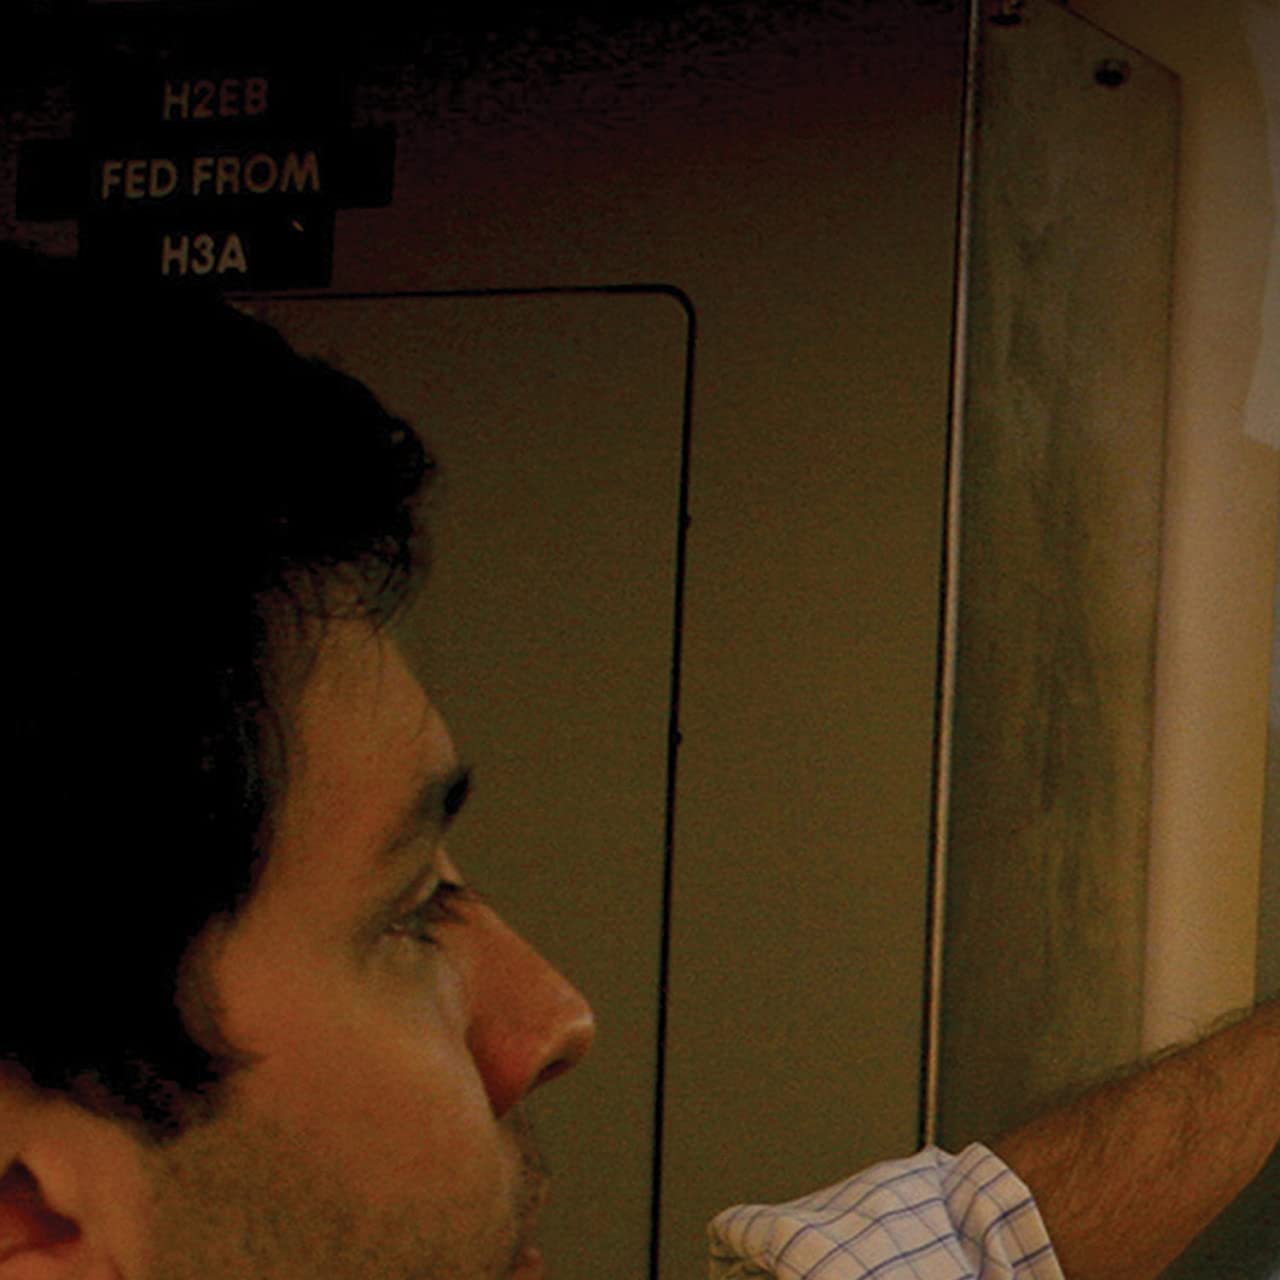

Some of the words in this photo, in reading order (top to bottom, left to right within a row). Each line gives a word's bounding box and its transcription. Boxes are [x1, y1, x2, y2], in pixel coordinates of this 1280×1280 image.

[163, 78, 270, 121] H2EB
[101, 159, 178, 200] FED
[191, 151, 321, 197] FROM
[161, 233, 248, 275] H3A
